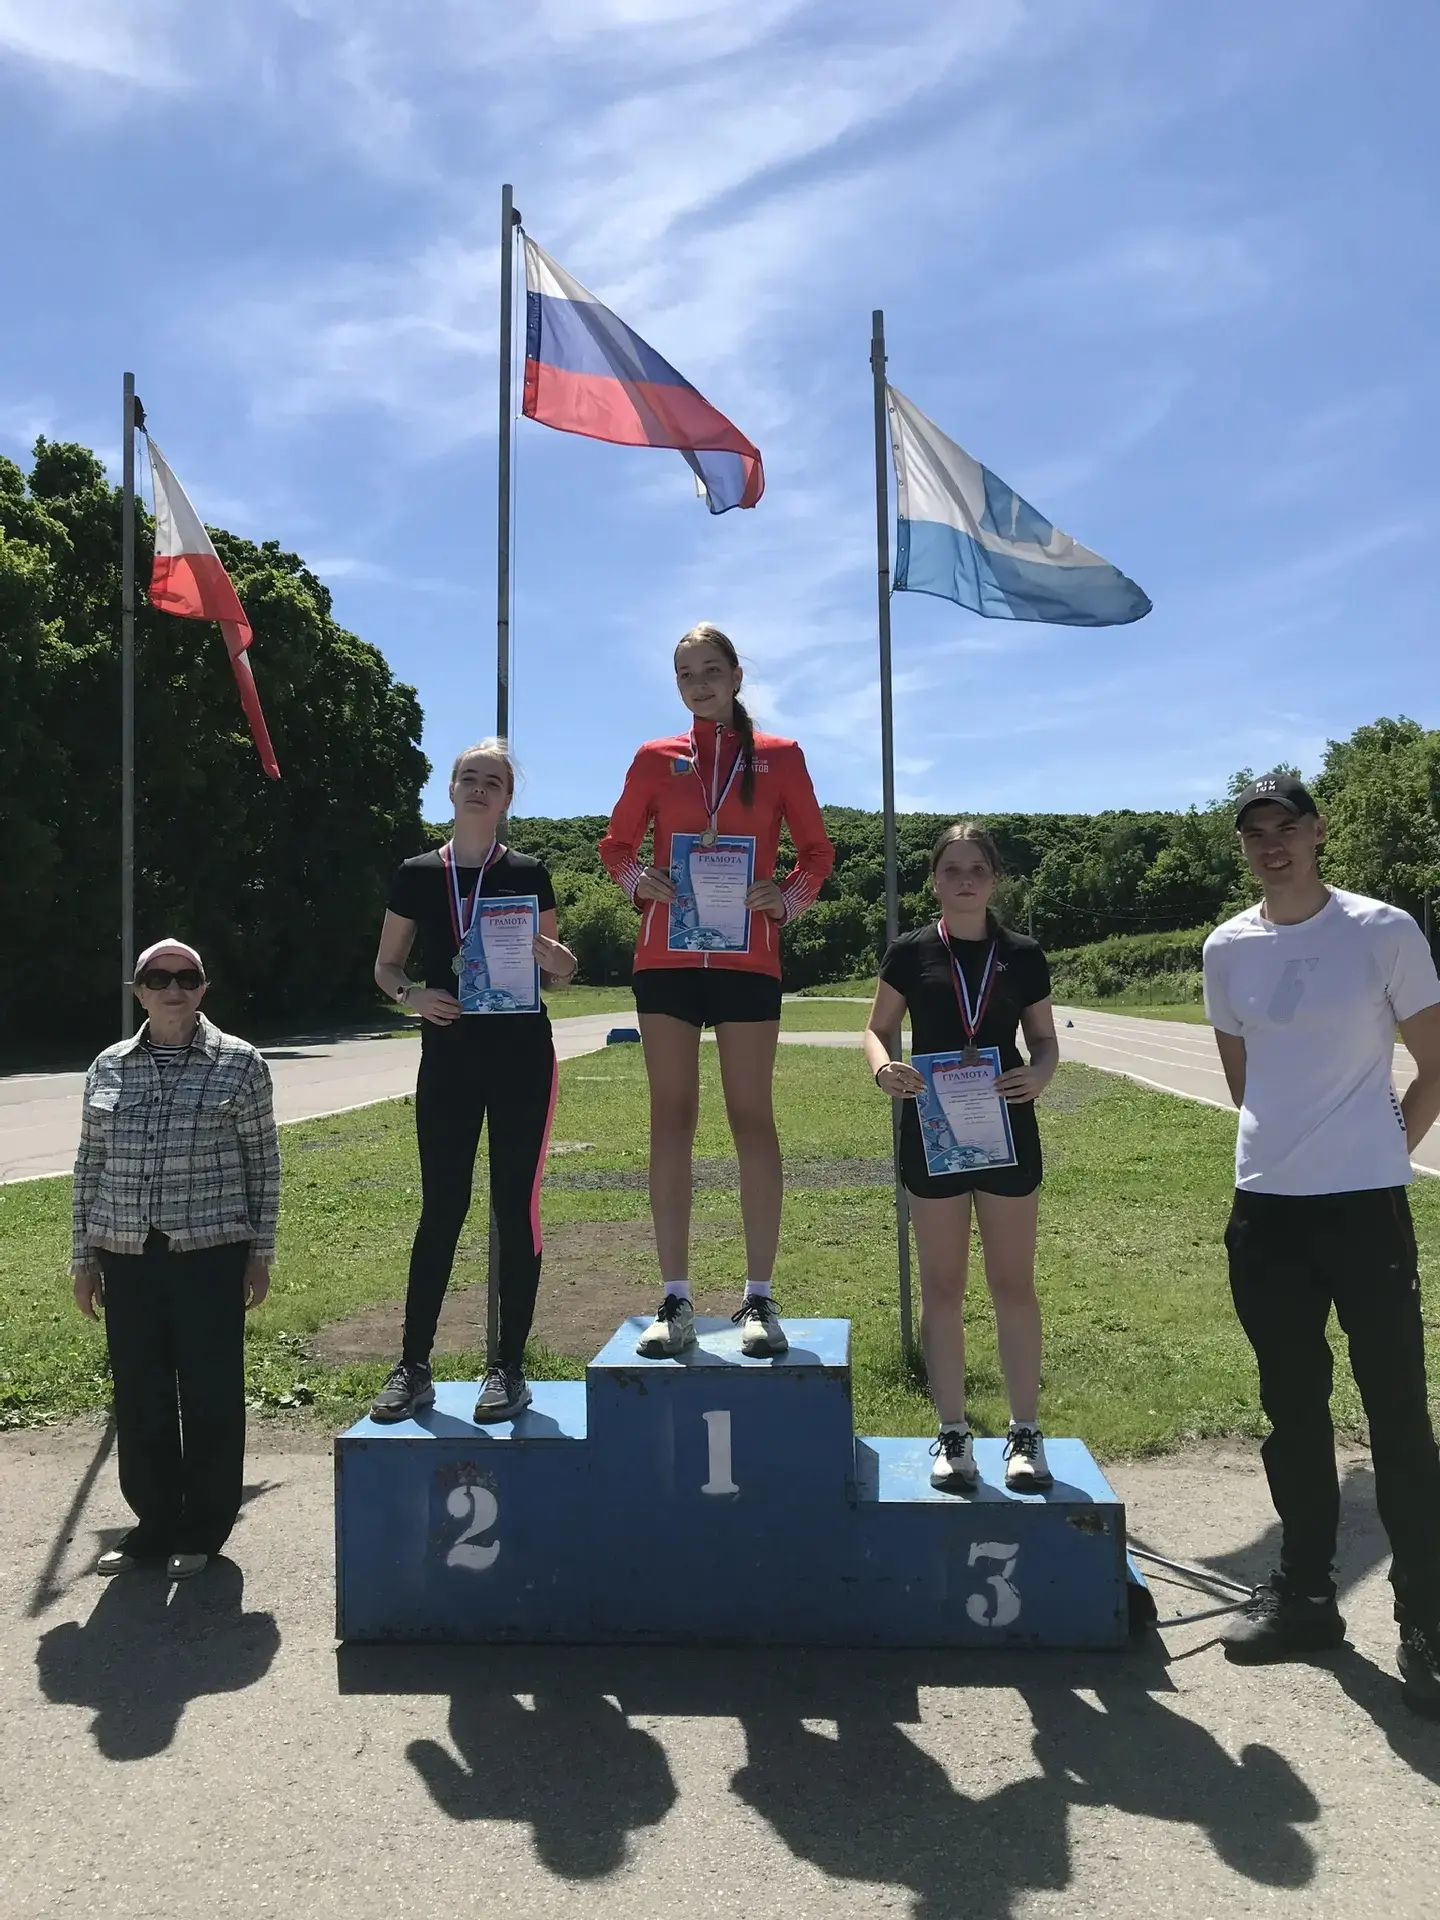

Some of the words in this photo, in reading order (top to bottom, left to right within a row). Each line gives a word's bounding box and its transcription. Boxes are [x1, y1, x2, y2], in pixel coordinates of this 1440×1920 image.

[698, 855, 742, 864] ГРАМОТА
[489, 917, 528, 926] ГРАМОТА
[942, 1070, 989, 1081] ГРАМОТА
[701, 1410, 740, 1494] 1
[446, 1485, 500, 1570] 2
[965, 1541, 1021, 1627] 3
